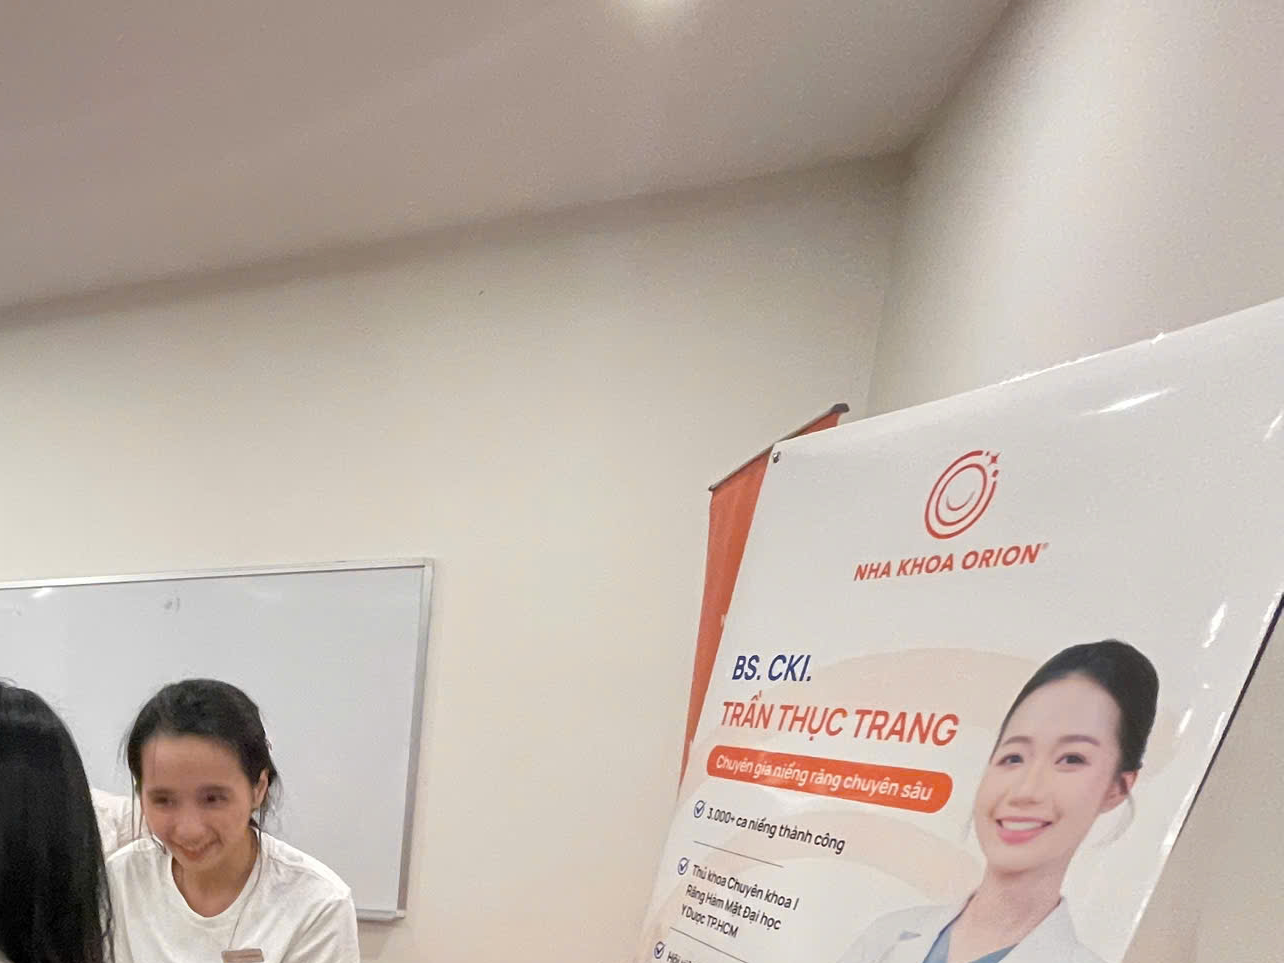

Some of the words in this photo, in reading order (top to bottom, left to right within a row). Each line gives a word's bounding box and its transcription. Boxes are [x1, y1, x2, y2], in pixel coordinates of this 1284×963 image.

[853, 559, 891, 581] NHA
[896, 552, 954, 576] KHOA
[961, 543, 1042, 570] ORION
[732, 655, 761, 681] BS.
[767, 654, 812, 682] CKI.
[777, 704, 848, 741] THỤC
[854, 709, 960, 746] TRANG
[716, 754, 753, 775] Chuyên
[752, 761, 772, 779] gia
[809, 768, 842, 791] răng
[843, 773, 899, 797] chuyên
[900, 781, 933, 800] sâu
[707, 807, 735, 823] 3.000+
[735, 817, 748, 828] ca
[814, 832, 846, 855] công
[707, 869, 727, 887] khoa
[727, 877, 764, 899] Chuyên
[763, 889, 792, 909] khoa
[681, 904, 687, 916] Y
[706, 914, 739, 938] TP.HCM
[742, 906, 760, 924] Đại
[760, 911, 782, 931] học
